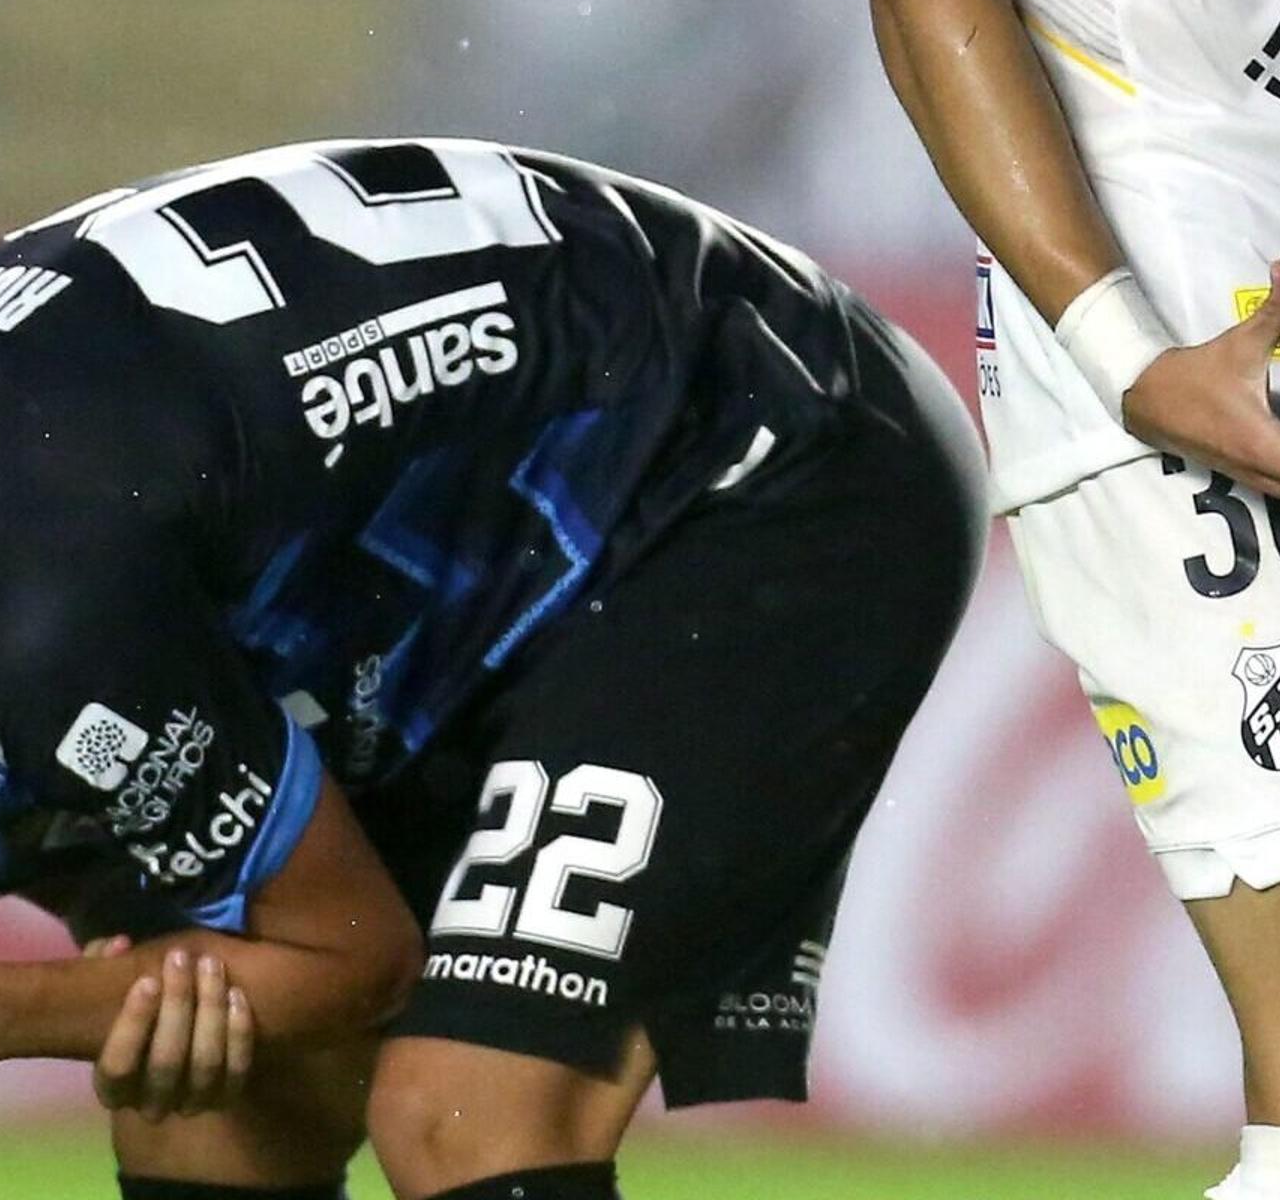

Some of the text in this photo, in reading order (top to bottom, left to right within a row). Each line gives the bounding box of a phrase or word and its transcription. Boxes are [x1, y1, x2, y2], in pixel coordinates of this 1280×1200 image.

[291, 322, 379, 373] SPORT
[302, 312, 518, 468] santé
[430, 760, 663, 959] 22
[424, 952, 608, 1006] marathon
